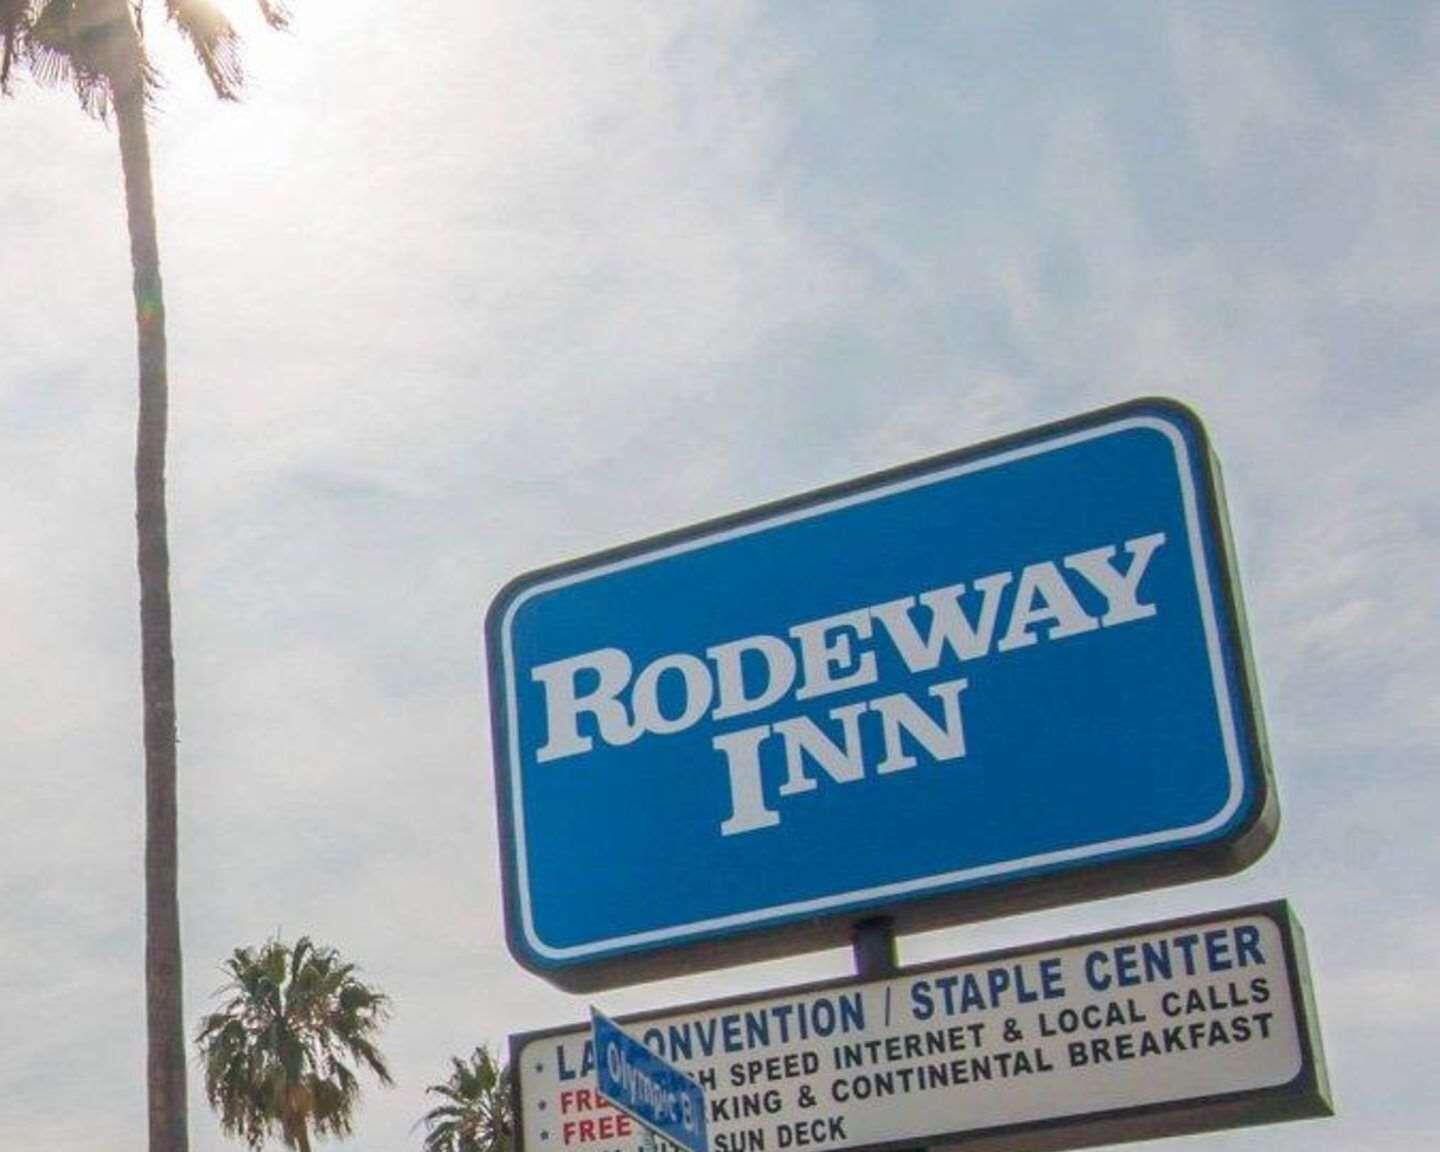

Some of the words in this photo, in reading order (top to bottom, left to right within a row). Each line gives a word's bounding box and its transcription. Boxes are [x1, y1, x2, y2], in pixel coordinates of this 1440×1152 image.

[532, 532, 1167, 764] RODEWAY
[712, 677, 970, 837] INN
[556, 1039, 595, 1081] LA
[643, 993, 865, 1063] ONVENTION
[911, 959, 1066, 1021] STAPLE
[1085, 924, 1266, 991] CENTER
[730, 1051, 819, 1087] SPEED
[834, 1023, 986, 1071] INTERNET
[1002, 1018, 1023, 1042] &
[1038, 998, 1147, 1038] LOCAL
[1161, 977, 1271, 1017] CALLS
[562, 1114, 632, 1145] FREE
[710, 1090, 782, 1122] KING
[798, 1084, 818, 1109] &
[831, 1048, 1054, 1101] CONTINENTAL
[1068, 1012, 1274, 1068] BREAKFAST
[607, 1041, 678, 1124] Olympic
[777, 1116, 848, 1150] DECK
